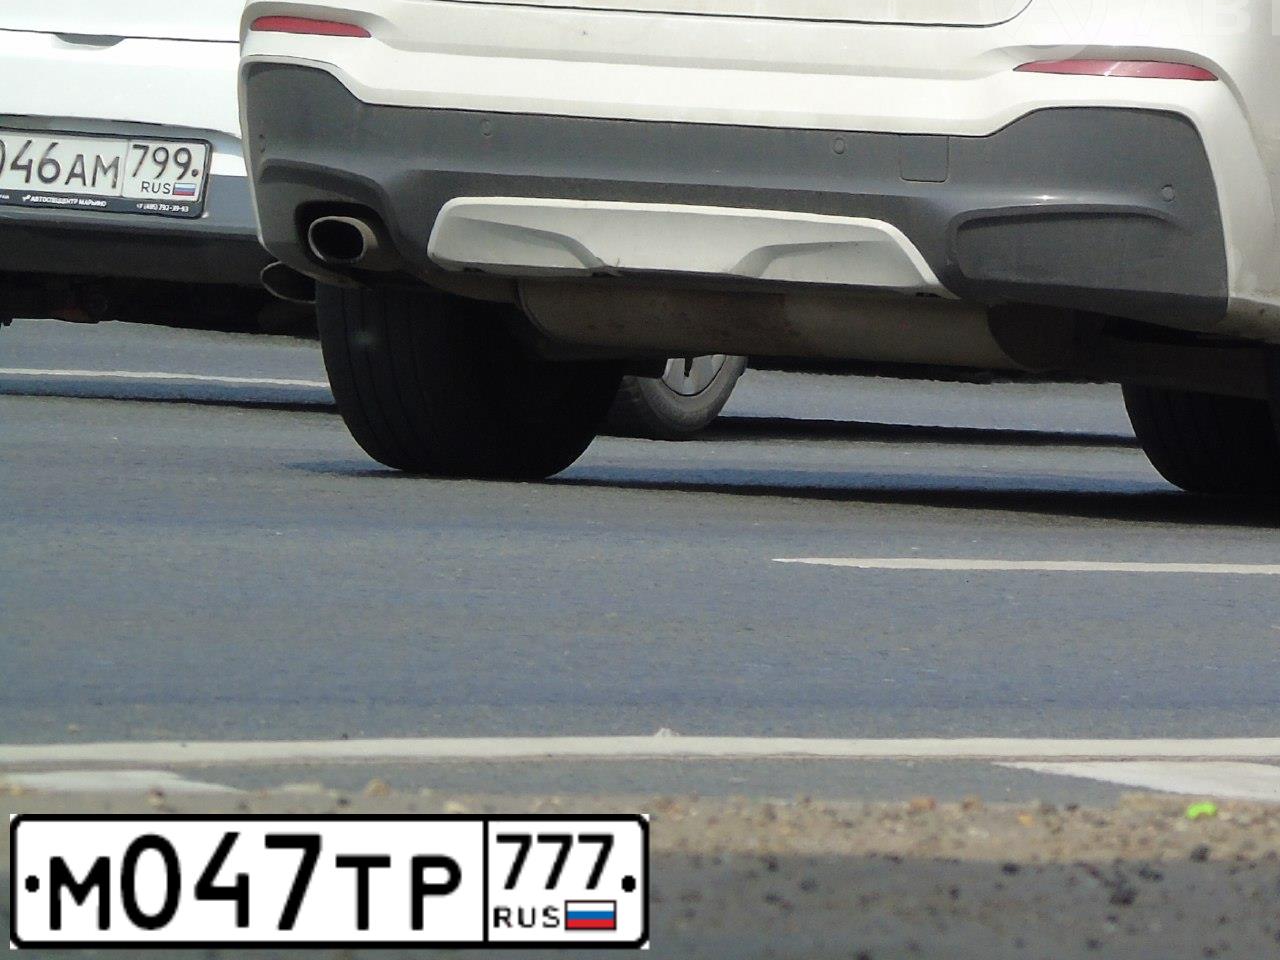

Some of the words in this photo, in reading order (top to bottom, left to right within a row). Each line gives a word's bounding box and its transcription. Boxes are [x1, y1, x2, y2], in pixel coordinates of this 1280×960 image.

[0, 139, 120, 189] 46АМ
[132, 144, 192, 180] 799
[141, 181, 171, 195] RUS
